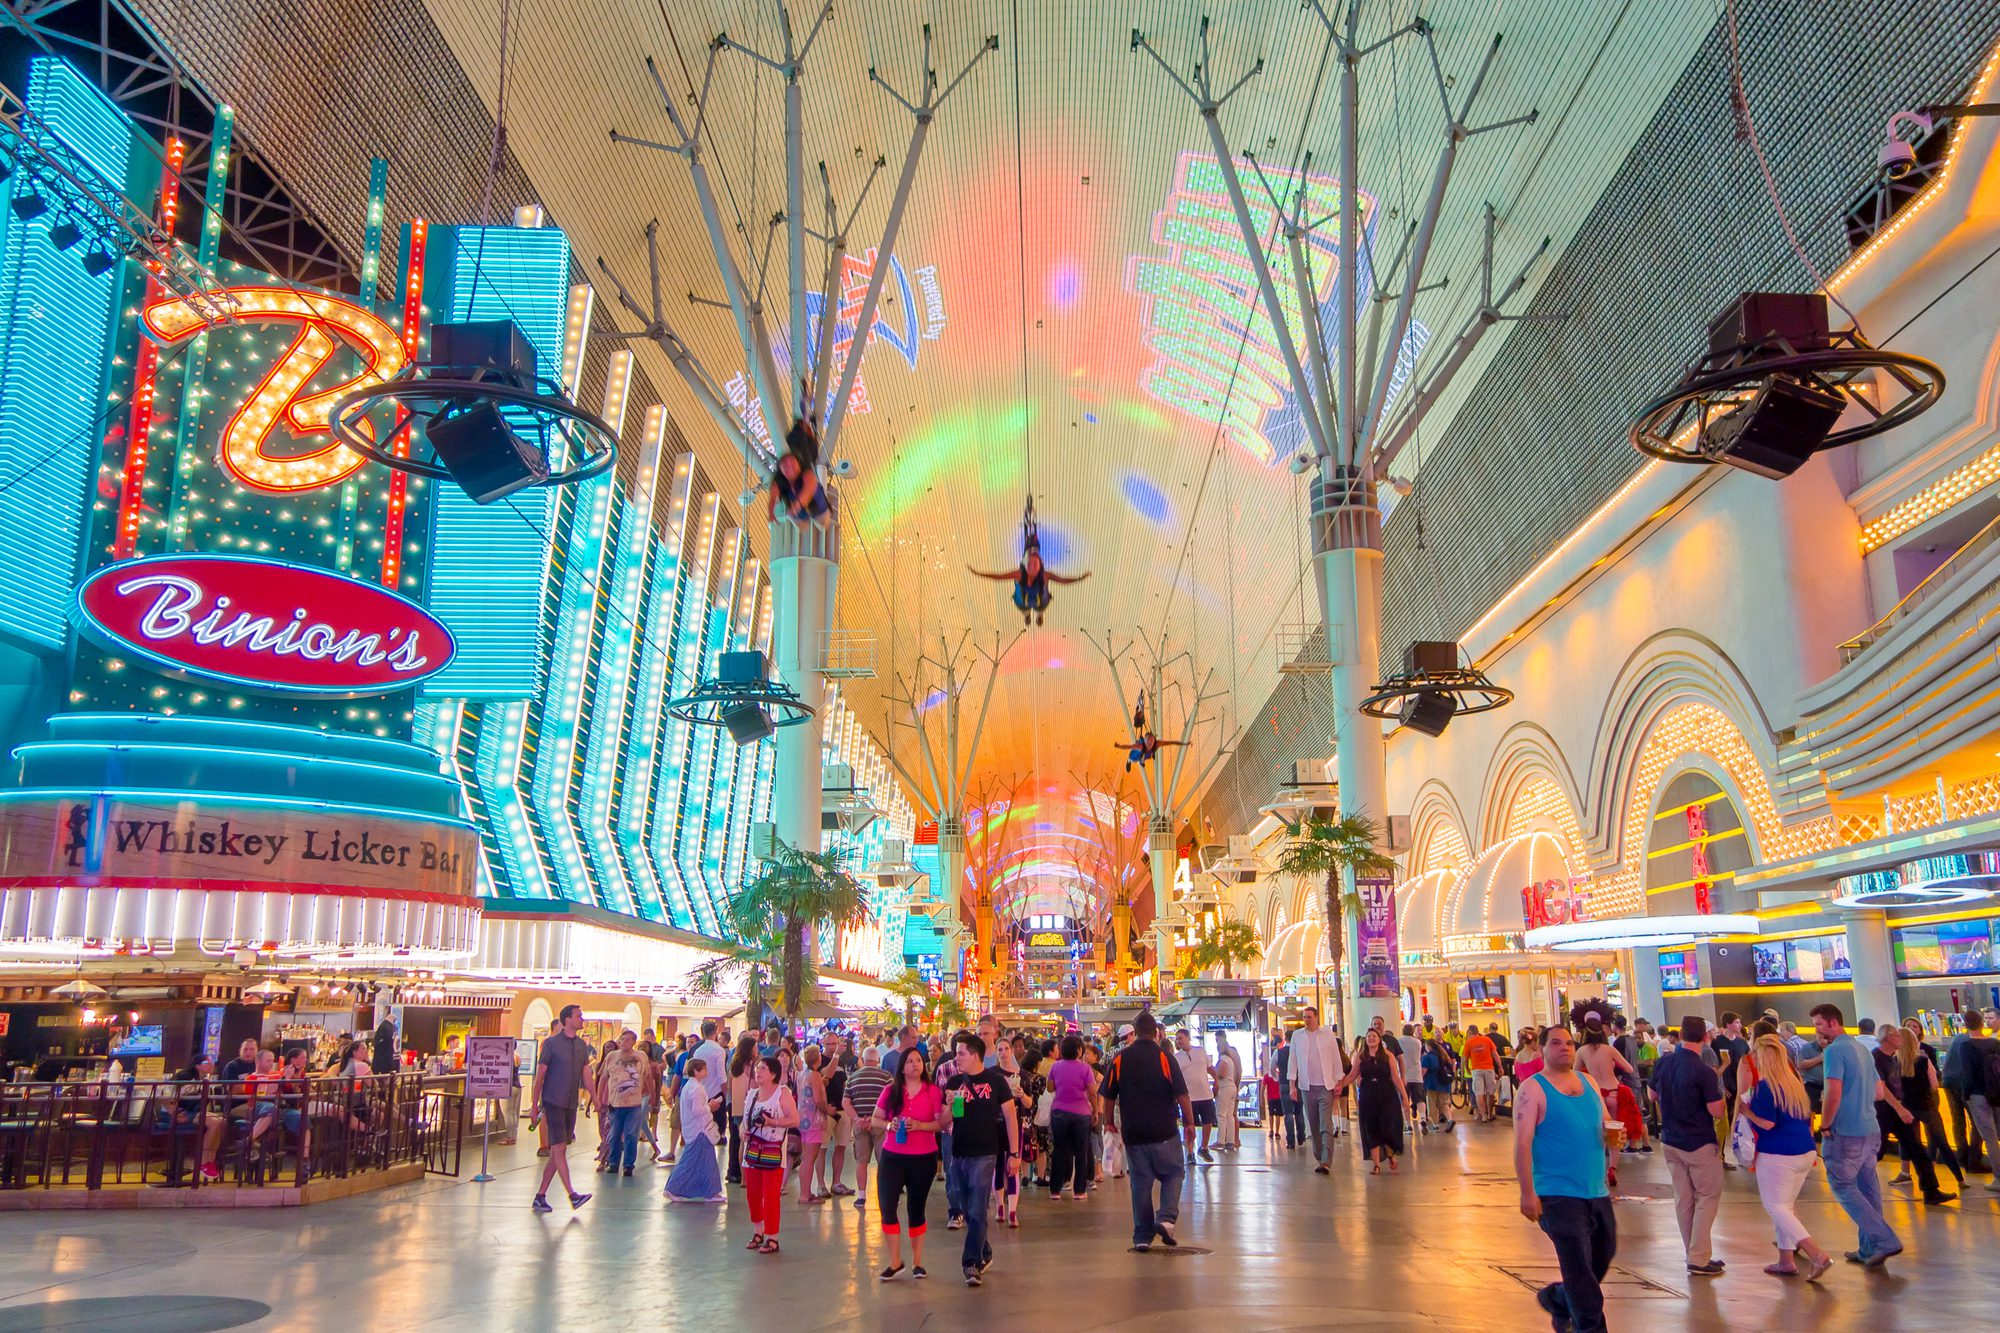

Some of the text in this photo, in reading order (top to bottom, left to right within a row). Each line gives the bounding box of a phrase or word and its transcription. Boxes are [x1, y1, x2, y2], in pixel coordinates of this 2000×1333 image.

[913, 265, 947, 341] Powered by
[118, 574, 427, 671] Binion's
[111, 819, 461, 873] Whiskey Licker Bar
[1357, 885, 1393, 907] FLY
[1363, 908, 1389, 920] THE
